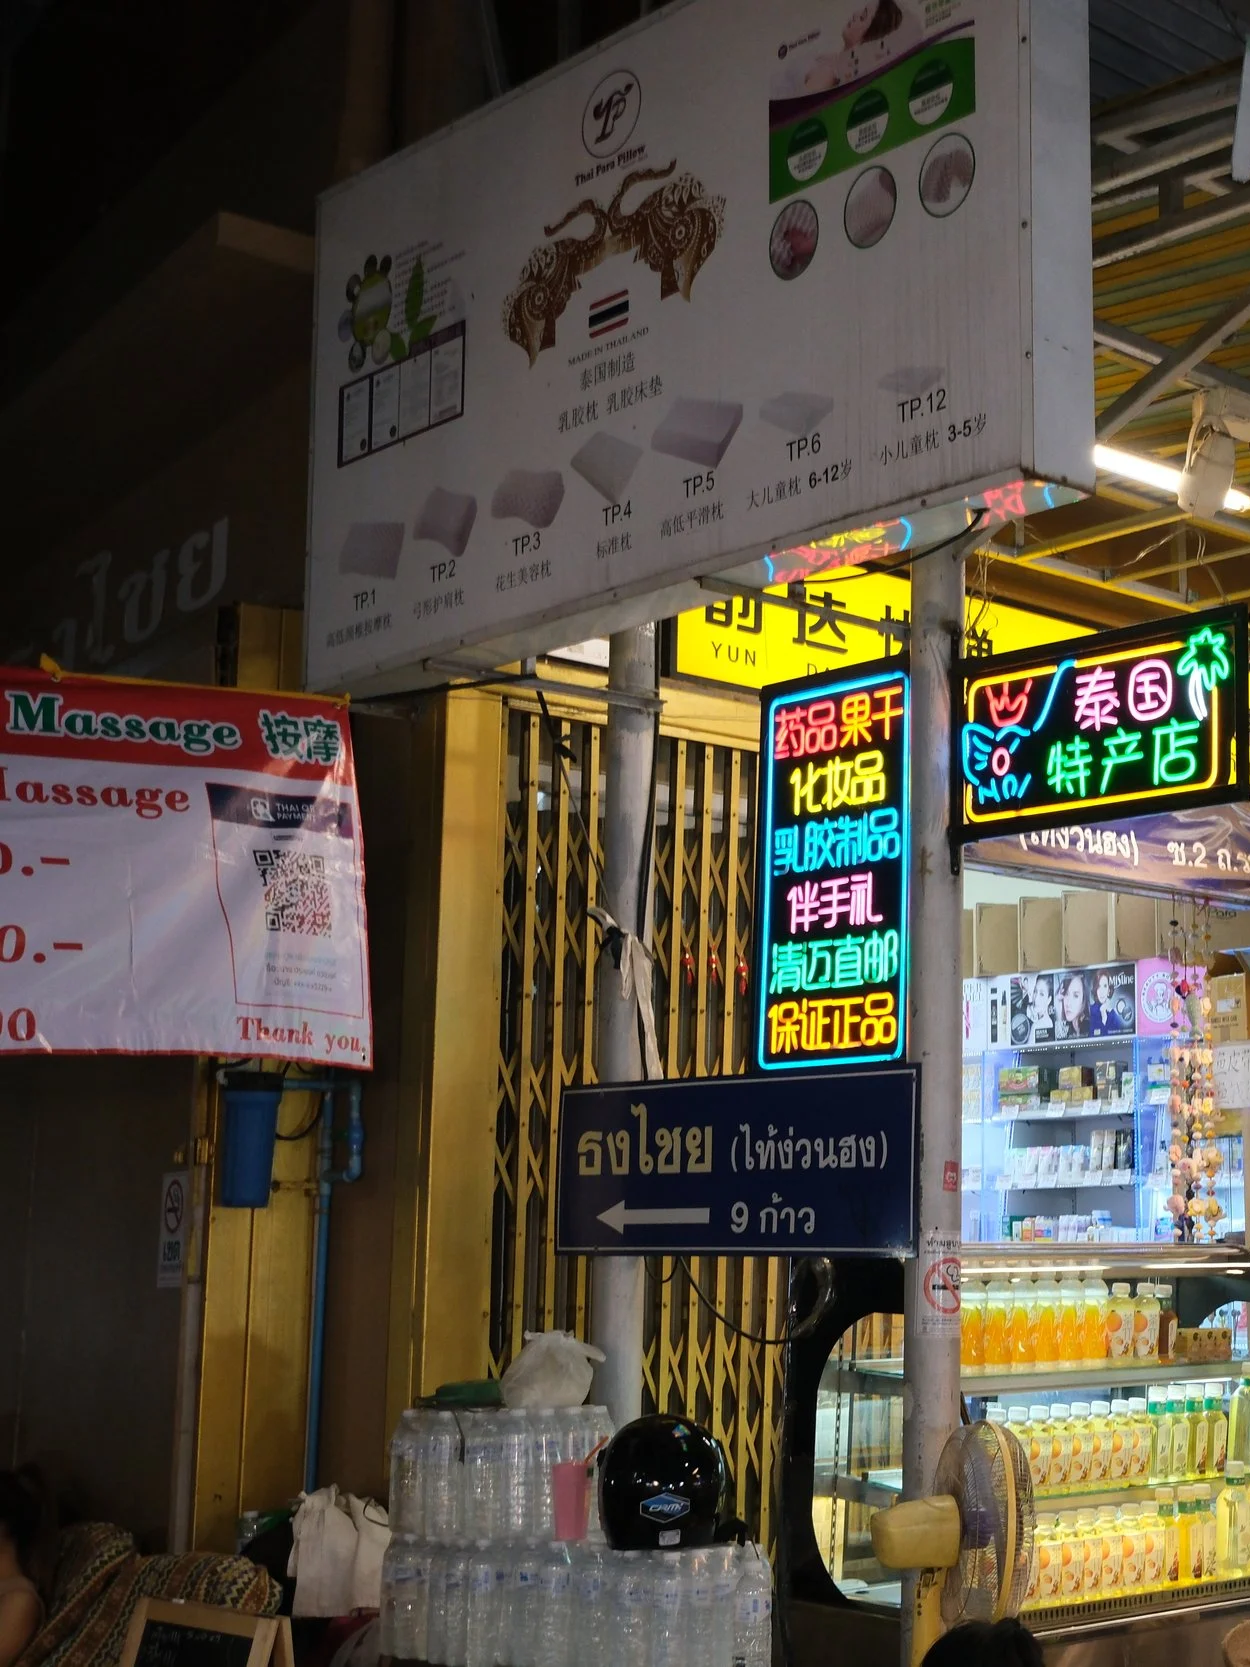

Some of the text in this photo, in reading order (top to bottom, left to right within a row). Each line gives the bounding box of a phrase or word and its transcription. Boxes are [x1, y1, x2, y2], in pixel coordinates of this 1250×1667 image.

[574, 167, 595, 187] Thai
[596, 158, 616, 177] Para
[617, 144, 646, 167] Pillow
[567, 326, 650, 367] MADE IN THAILAND
[580, 351, 636, 392] 泰国制造
[558, 374, 663, 433] 乳胶枕 乳胶床垫
[897, 388, 947, 423] TP.12
[786, 432, 821, 462] TP.6
[879, 412, 987, 466] 小儿童枕 3-5岁
[682, 470, 716, 498] TP.5
[746, 458, 852, 511] 大儿童枕 6-12岁
[602, 500, 632, 527] TP.4
[512, 531, 541, 557] TP.3
[596, 531, 633, 559] 标准枕
[430, 559, 457, 584] TP.2
[353, 589, 377, 612] TP.1
[711, 640, 758, 668] YUN
[1074, 657, 1174, 732] 泰国
[6, 691, 342, 765] Massage 按摩
[773, 685, 905, 761] 药品果干
[1046, 716, 1200, 799] 特产店
[0, 766, 191, 819] assage
[788, 749, 887, 816] 化妆品
[772, 806, 902, 877] 乳胶制品
[786, 870, 884, 935] 伴手礼
[768, 928, 899, 995] 清迈直邮
[0, 1007, 37, 1042] 0
[236, 1015, 314, 1046] Thank
[766, 991, 898, 1054] 保证正品
[577, 1103, 714, 1176] ธงไชย
[730, 1192, 816, 1236] 9 ก้าว
